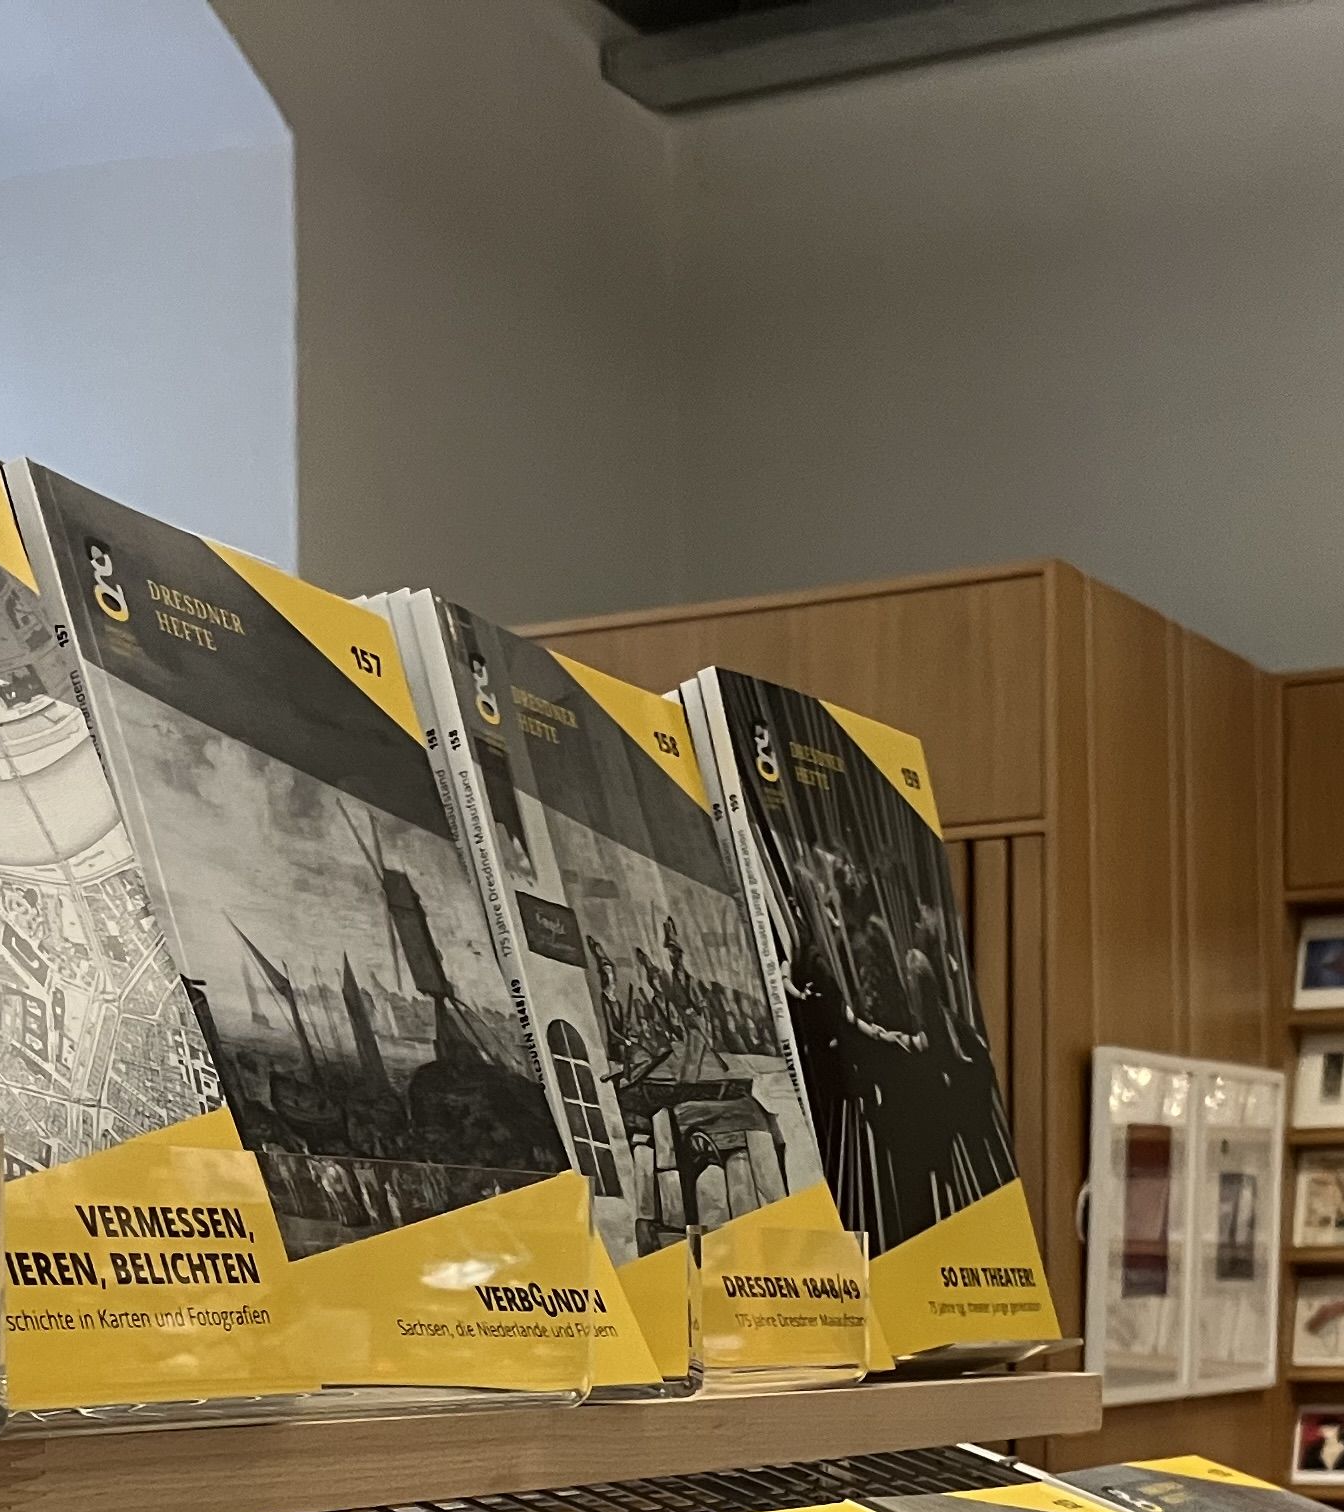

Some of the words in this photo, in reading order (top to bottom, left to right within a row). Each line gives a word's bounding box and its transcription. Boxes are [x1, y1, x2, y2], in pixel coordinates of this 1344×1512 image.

[146, 579, 246, 636] DRESDNER
[54, 624, 70, 648] 157
[155, 610, 217, 651] HEFTE
[351, 645, 382, 677] 157
[511, 685, 579, 729] DRESDNER
[449, 730, 461, 751] 158
[518, 712, 560, 745] HEFTE
[654, 731, 679, 758] 158
[75, 1205, 255, 1243] VERMESSEN,
[115, 1252, 260, 1285] BELICHTEN
[941, 1267, 958, 1288] SO
[959, 1268, 981, 1288] EIN
[981, 1267, 1036, 1288] THEATER!
[722, 1275, 800, 1299] DRESDEN
[802, 1273, 861, 1304] 1848/49
[79, 1309, 94, 1330] in
[99, 1308, 151, 1329] Karten
[155, 1306, 185, 1328] und
[188, 1305, 271, 1332] Fotografien
[397, 1319, 454, 1339] Sachsen,
[456, 1321, 474, 1337] die
[476, 1322, 549, 1338] Niederlande
[552, 1322, 574, 1338] und
